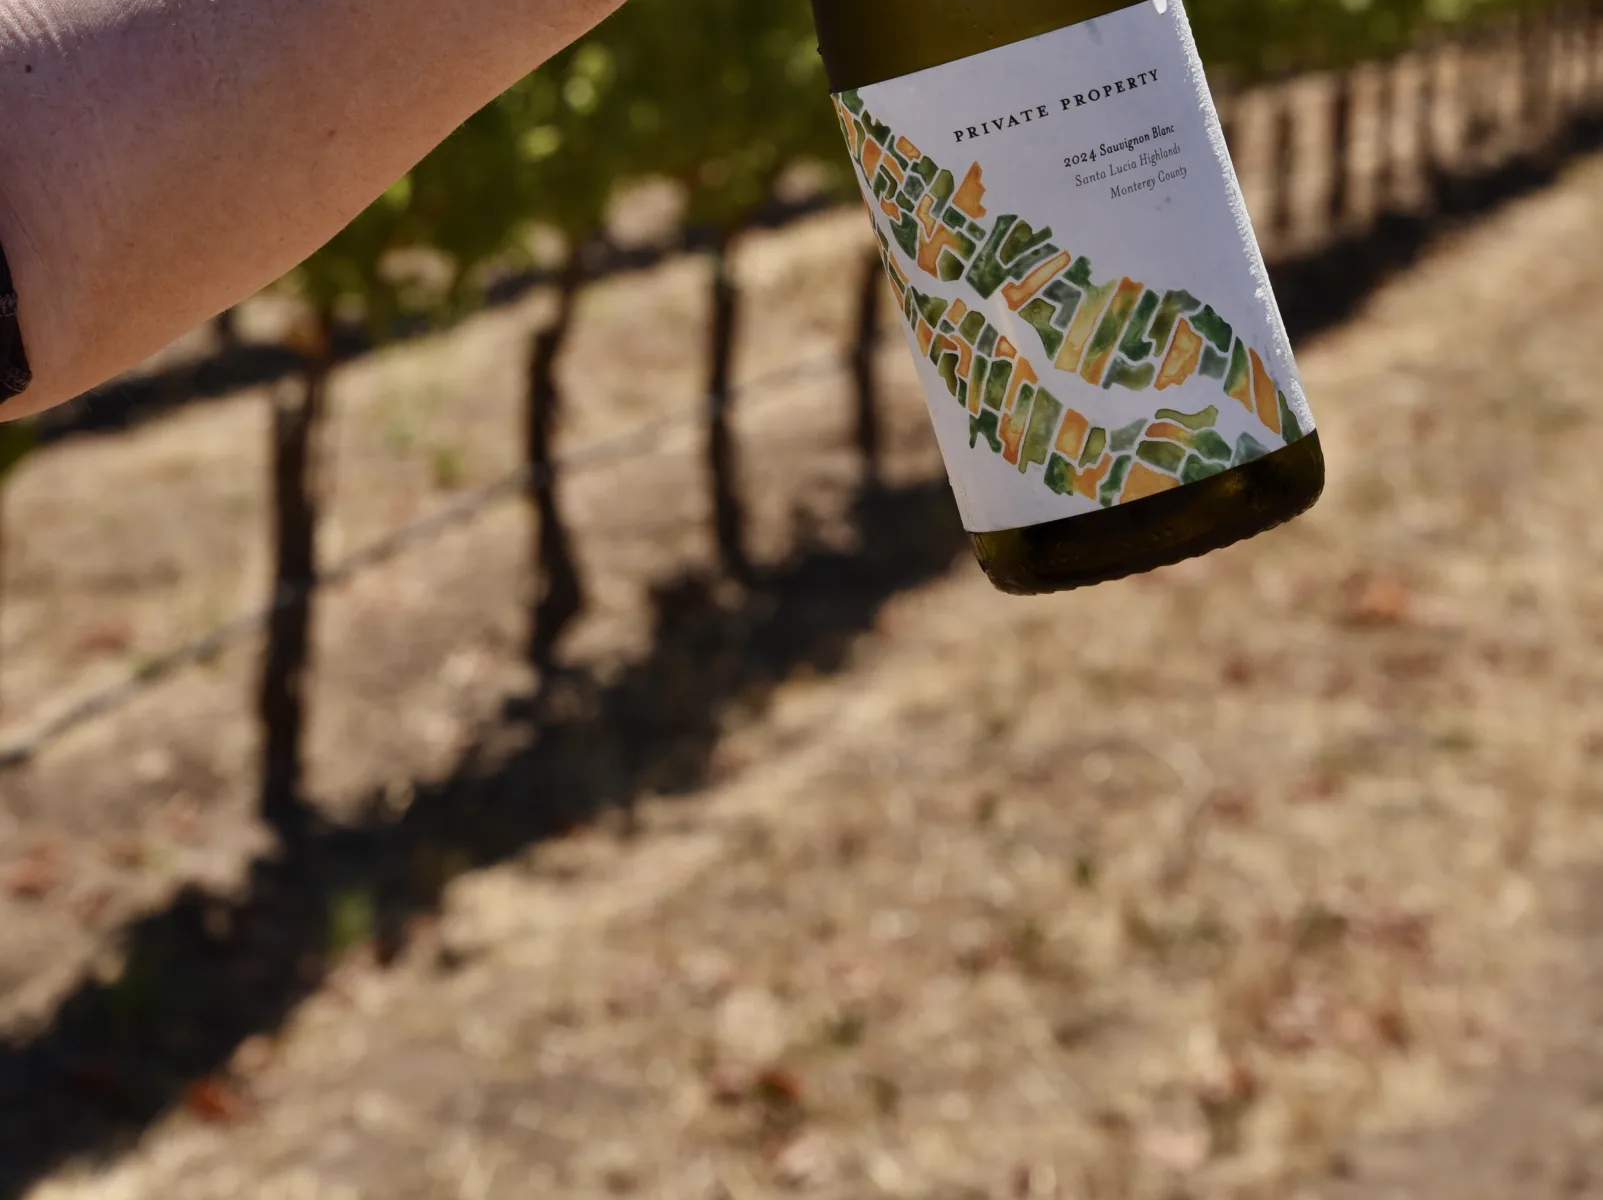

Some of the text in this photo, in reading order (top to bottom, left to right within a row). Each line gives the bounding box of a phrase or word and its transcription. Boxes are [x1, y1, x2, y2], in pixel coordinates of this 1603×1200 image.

[953, 69, 1158, 143] PRIVATE PROPERTY
[1063, 124, 1175, 167] 2024 Sauvignon Blanc
[1075, 143, 1181, 187] Santa Lucia Highlands
[1110, 165, 1187, 200] Monterey County
